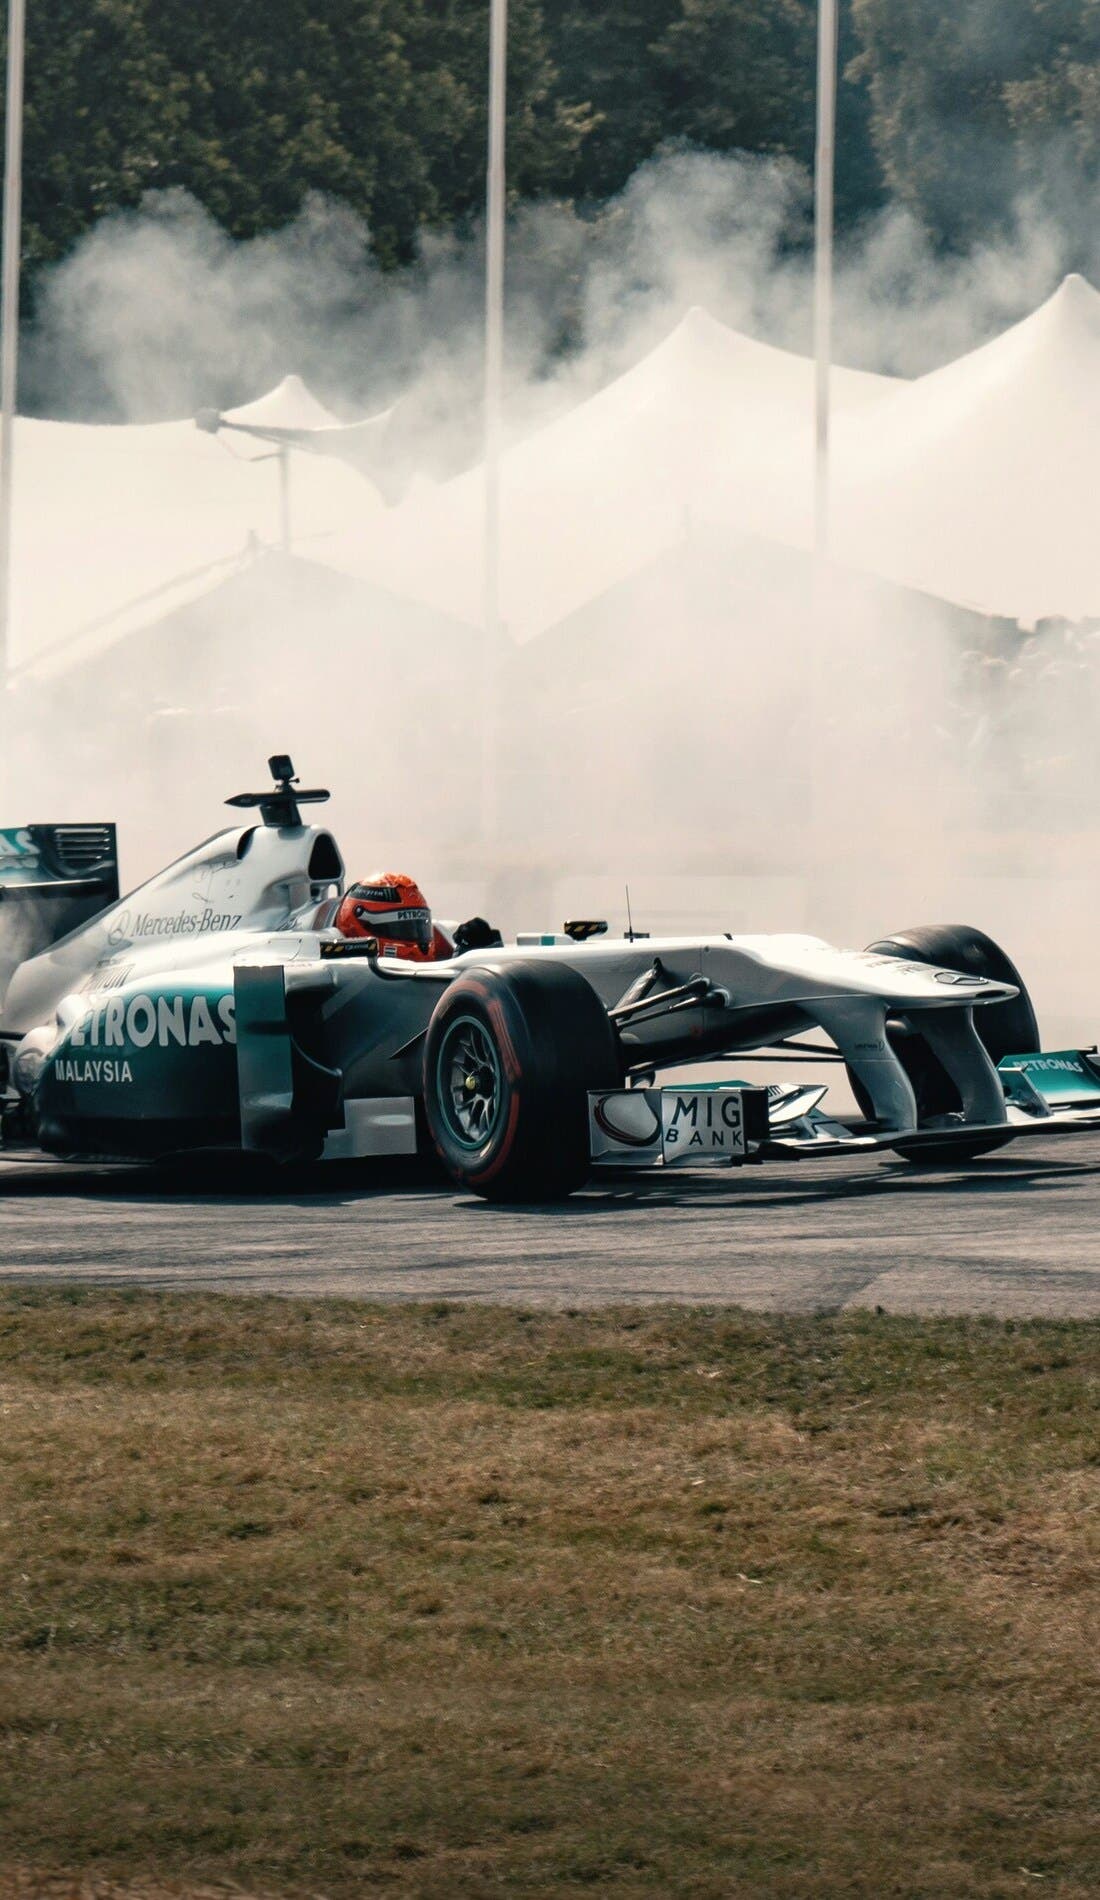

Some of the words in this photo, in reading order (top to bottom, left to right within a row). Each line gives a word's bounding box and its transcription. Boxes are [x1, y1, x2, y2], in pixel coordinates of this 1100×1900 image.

[130, 908, 242, 937] Mercedes-Benz
[55, 1060, 133, 1083] MALAYSIA
[671, 1096, 740, 1128] MIG
[665, 1128, 743, 1146] BANK
